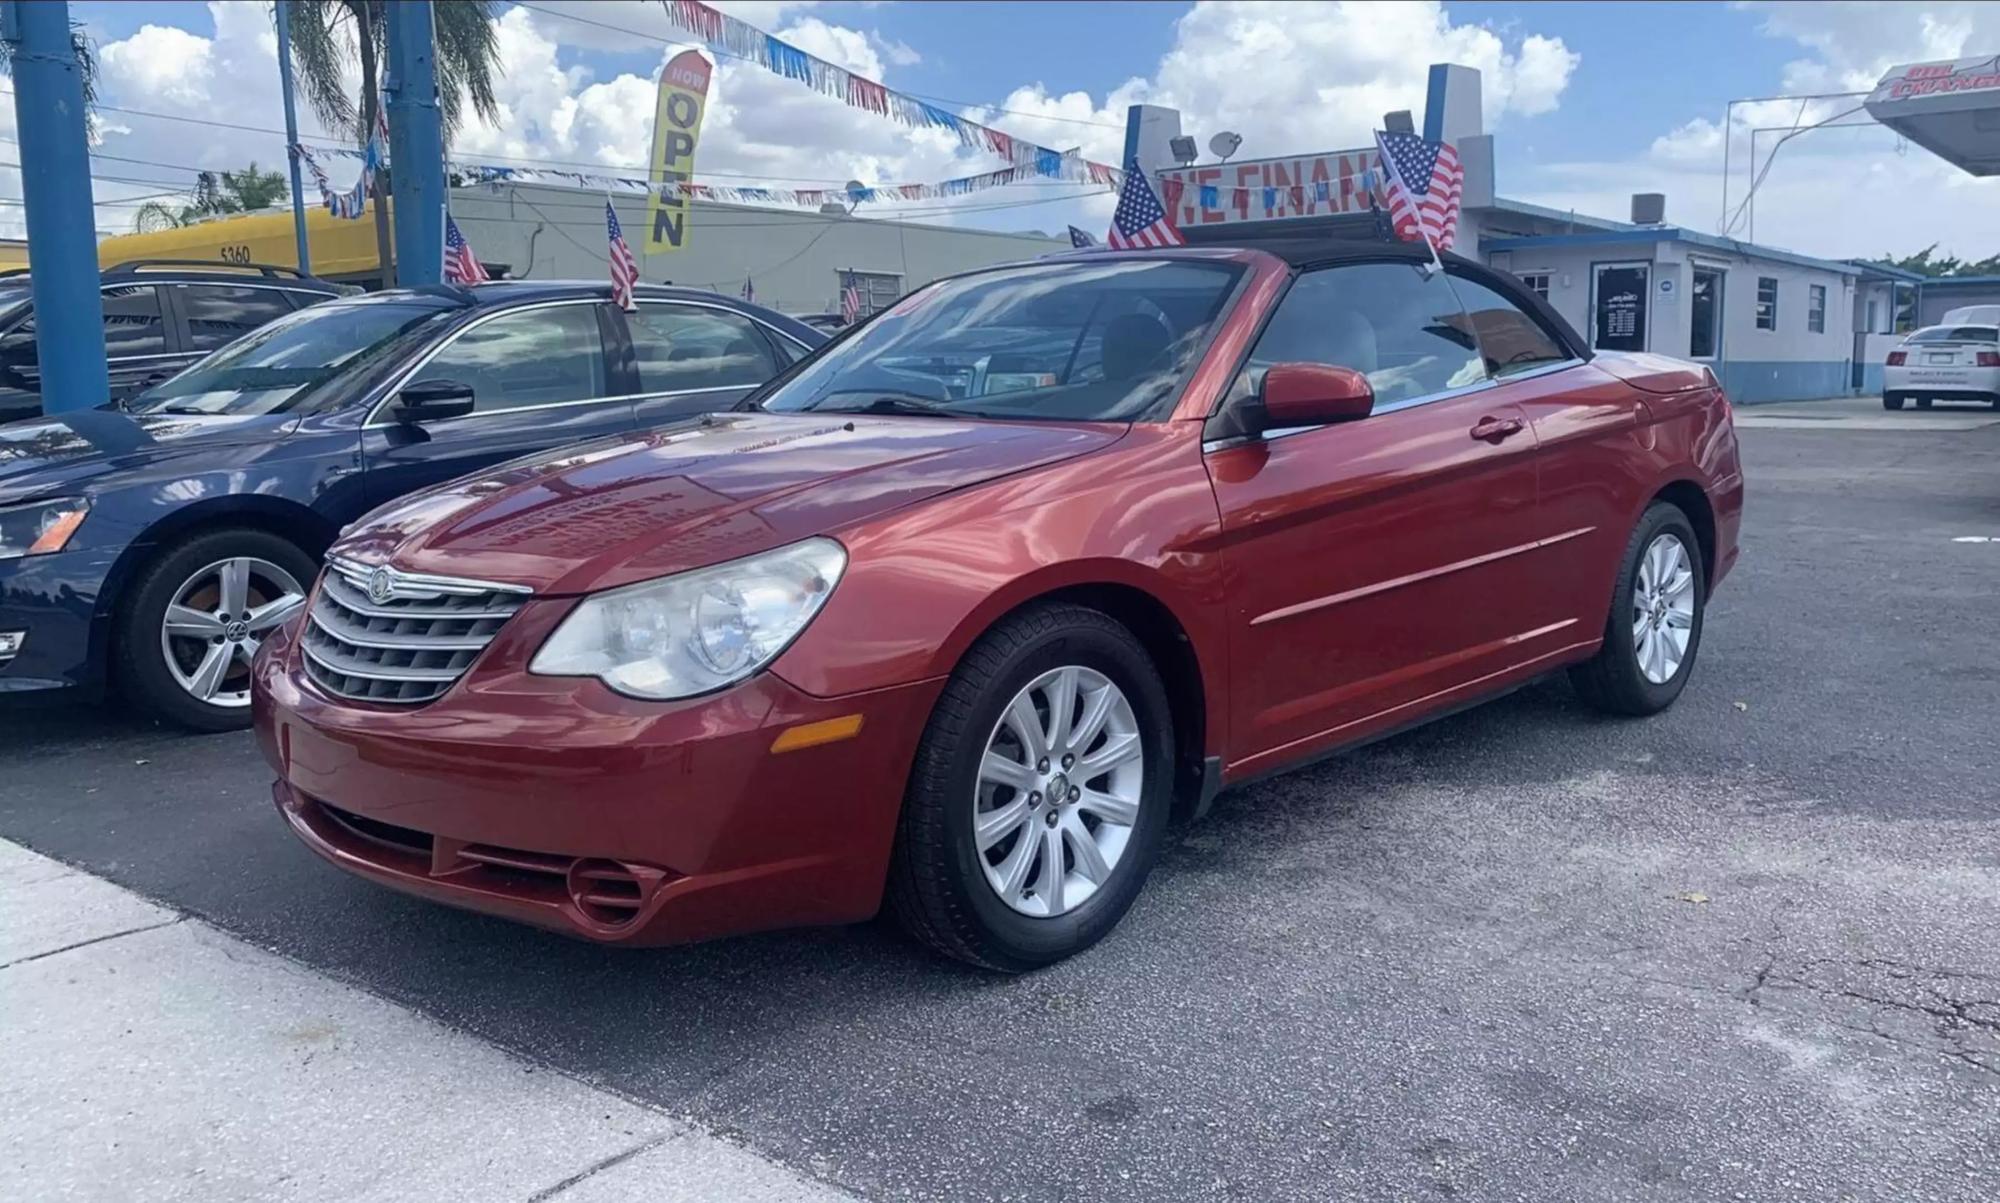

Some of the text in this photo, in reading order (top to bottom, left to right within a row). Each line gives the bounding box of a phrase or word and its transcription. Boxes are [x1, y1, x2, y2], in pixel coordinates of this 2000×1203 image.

[672, 67, 705, 89] NOW
[653, 92, 698, 248] OPEN
[1163, 168, 1225, 226] WE
